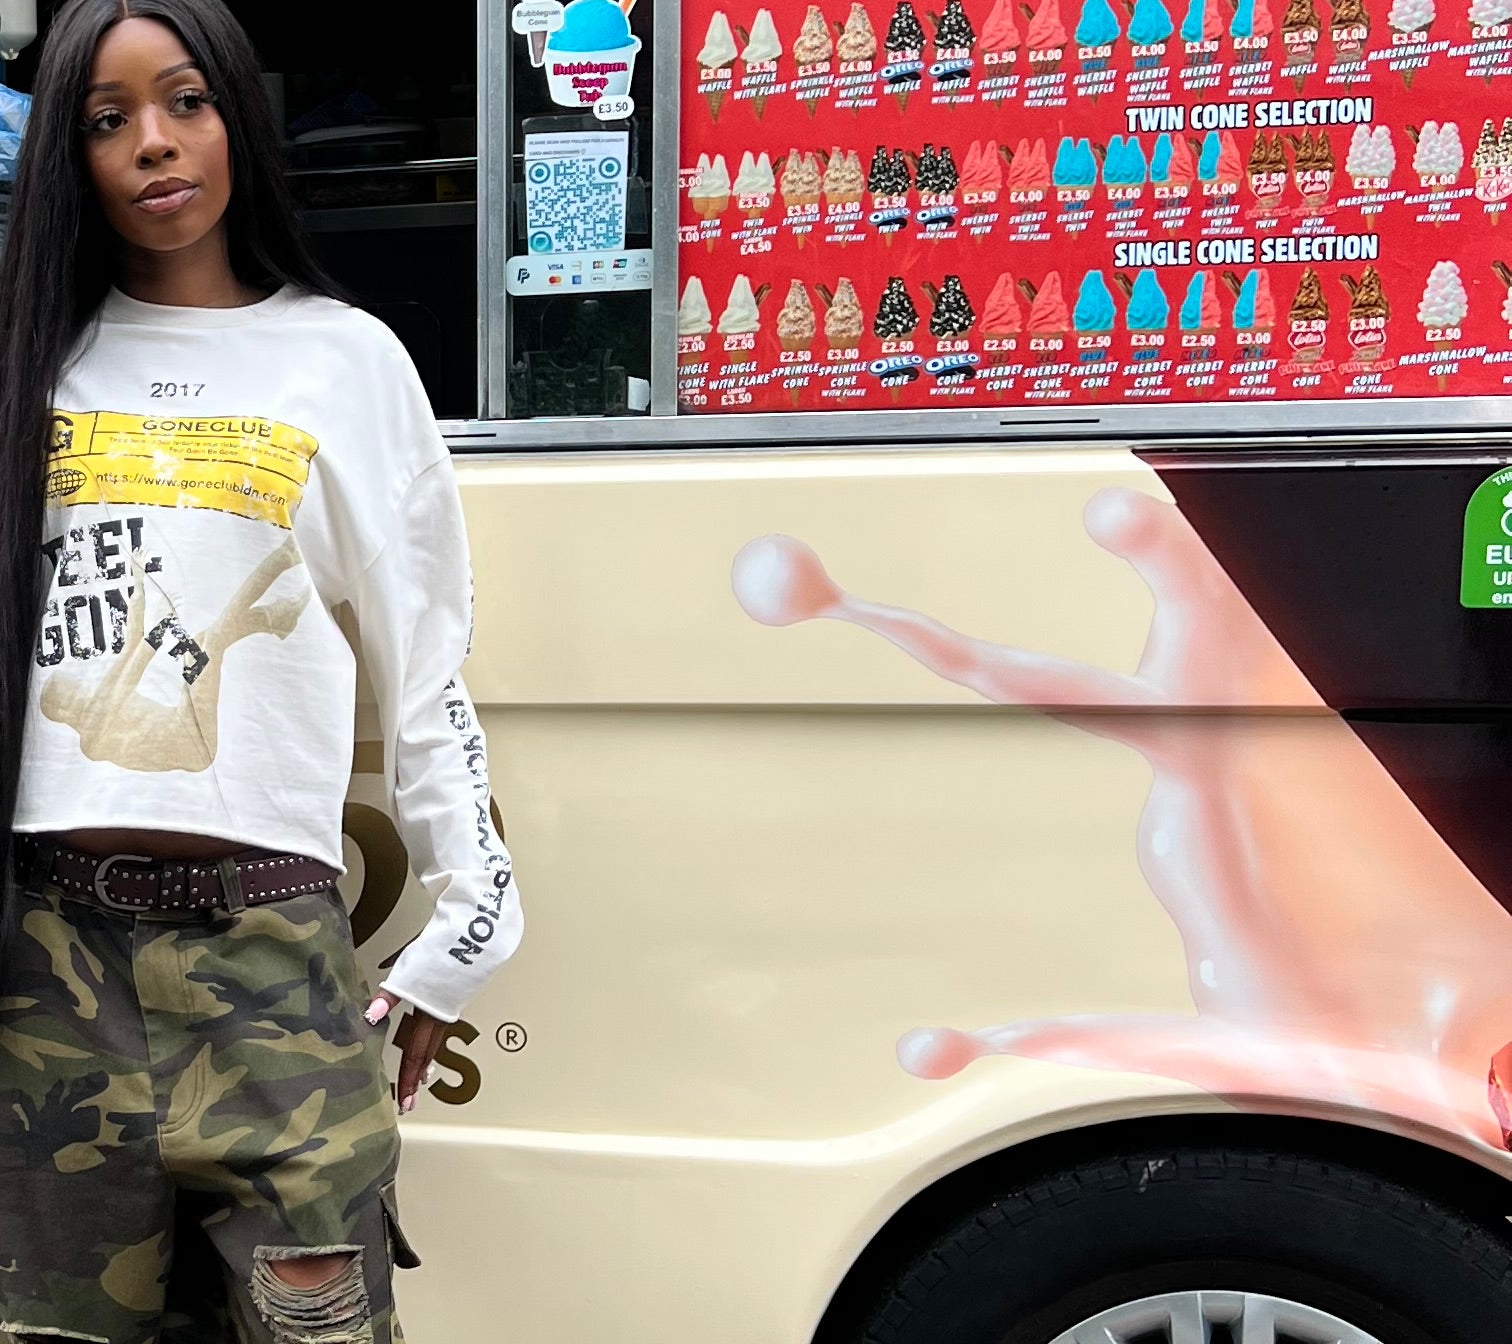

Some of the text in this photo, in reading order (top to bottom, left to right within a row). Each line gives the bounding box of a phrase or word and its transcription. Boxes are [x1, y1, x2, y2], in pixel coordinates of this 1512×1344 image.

[1368, 41, 1449, 61] MARSHMALLOW
[697, 80, 733, 95] WAFFLE
[598, 100, 629, 115] £3.50
[1126, 98, 1372, 132] TWIN CONE SELECTION
[1114, 235, 1378, 267] SINGLE CONE SELECTION
[1425, 328, 1461, 342] £2.50
[881, 340, 914, 353] £2.50
[1399, 347, 1486, 366] MARSHMALLOW
[869, 355, 923, 375] OREO
[1428, 362, 1458, 376] CONE
[881, 374, 909, 387] CONE
[150, 382, 206, 398] 2017
[143, 419, 272, 438] GONECLUB
